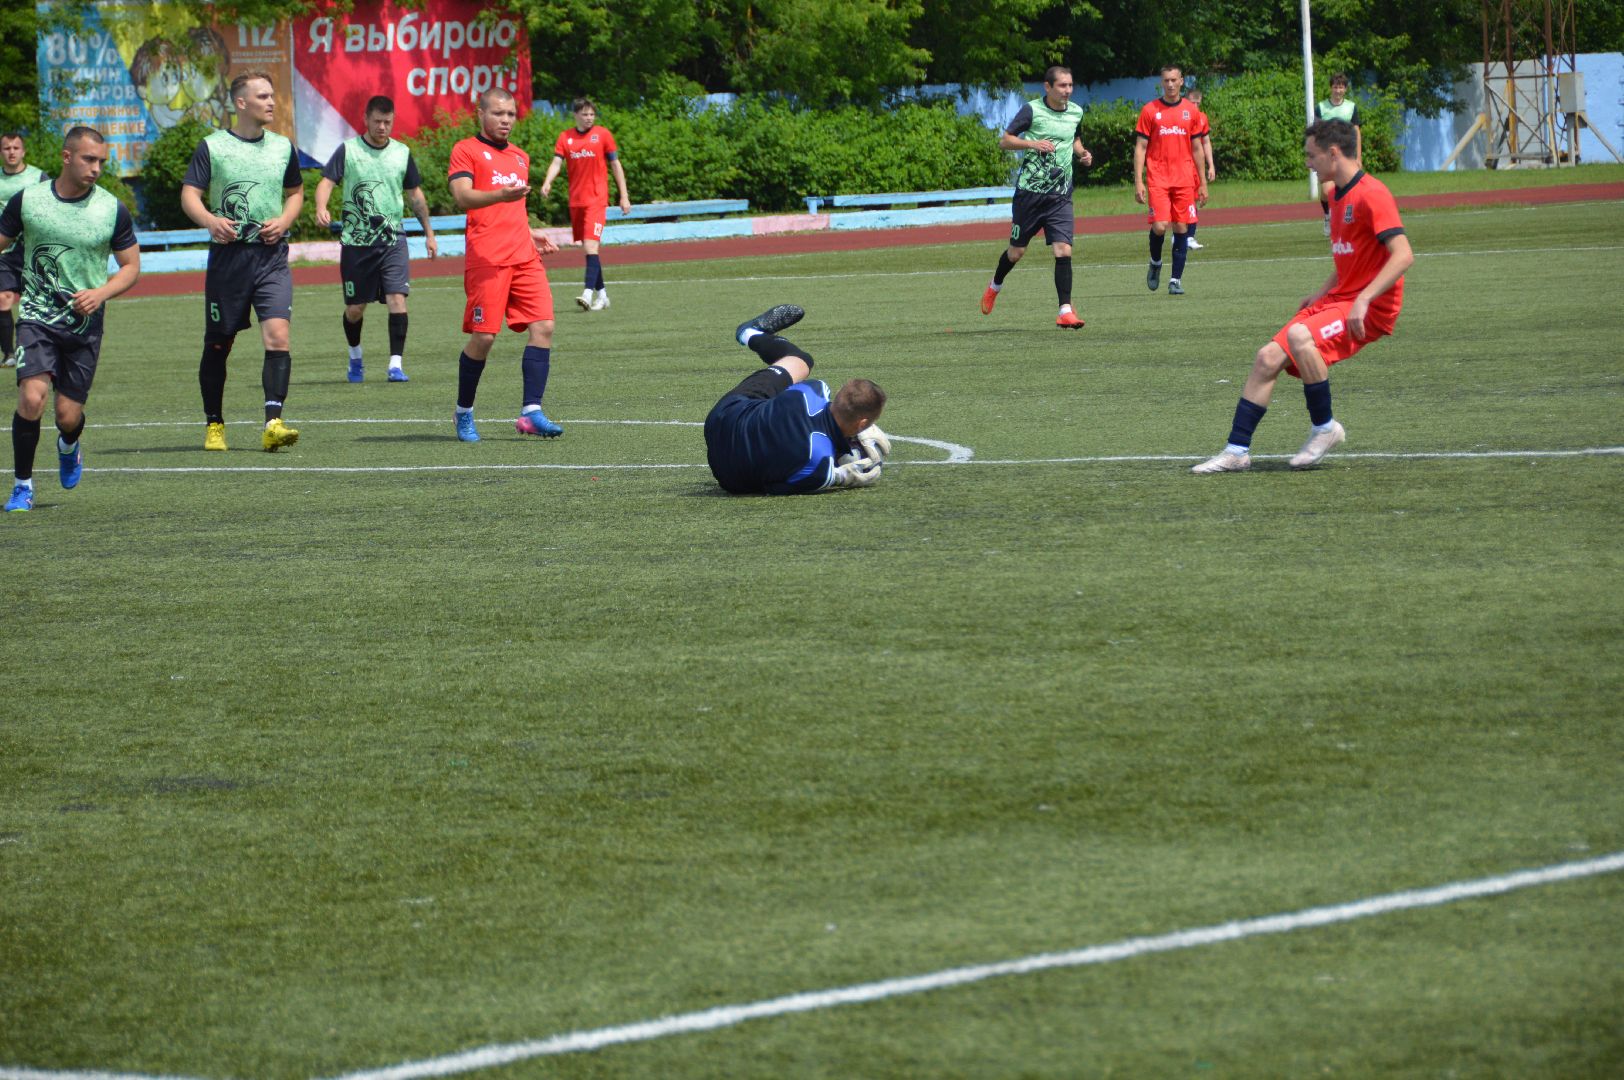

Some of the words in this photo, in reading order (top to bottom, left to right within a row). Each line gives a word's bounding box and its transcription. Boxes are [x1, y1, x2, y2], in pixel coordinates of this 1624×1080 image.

[308, 17, 334, 53] Я
[344, 12, 516, 59] выбираю
[406, 61, 518, 103] спорт!
[345, 281, 355, 297] 19
[210, 302, 221, 322] 5
[1320, 319, 1344, 339] 8
